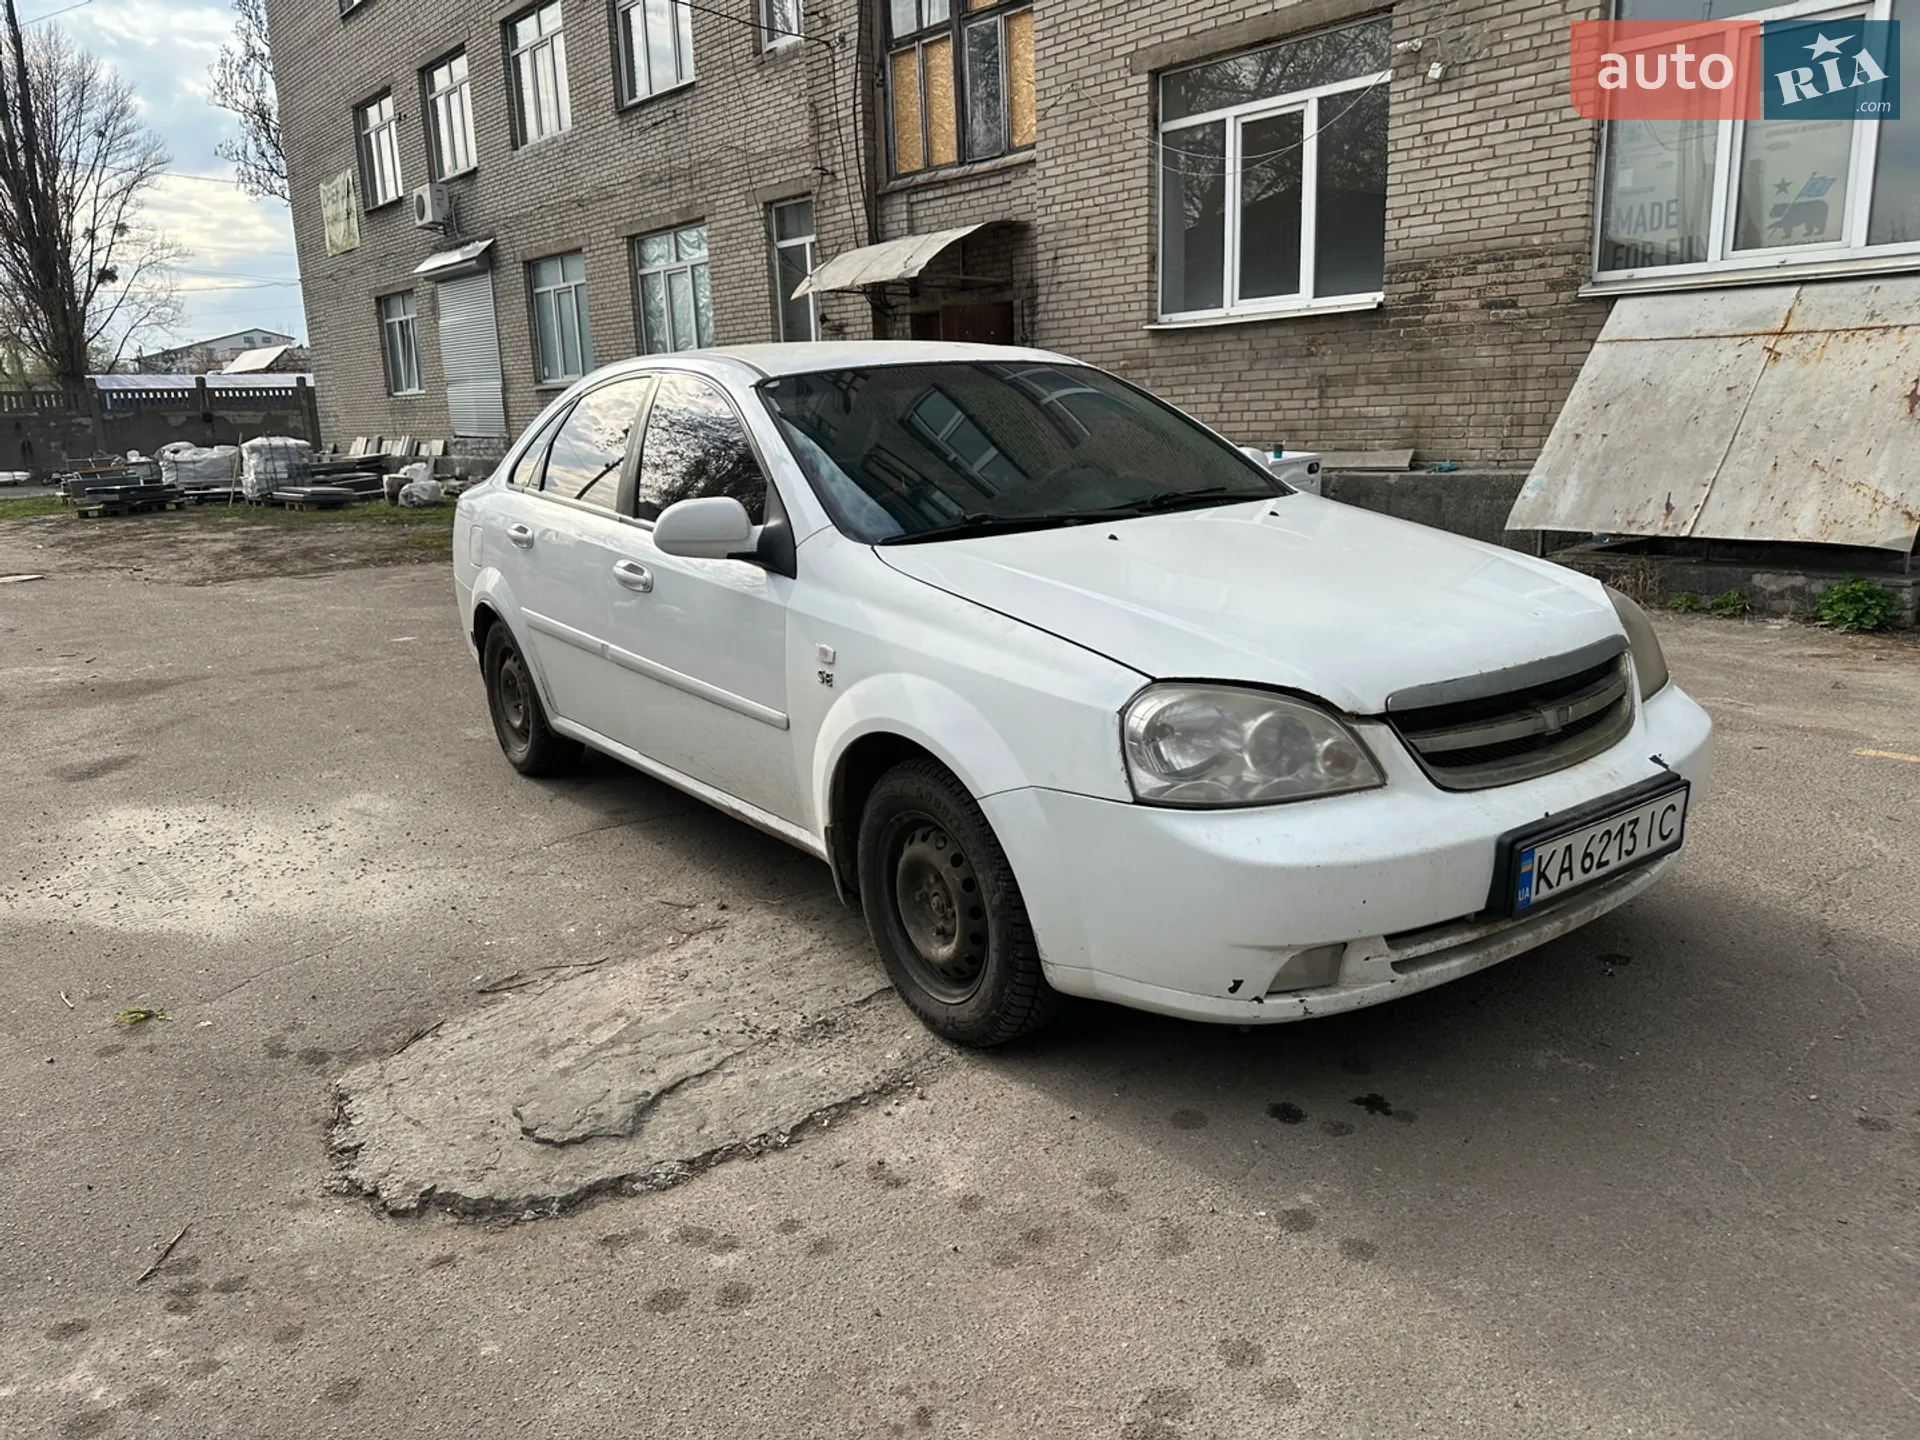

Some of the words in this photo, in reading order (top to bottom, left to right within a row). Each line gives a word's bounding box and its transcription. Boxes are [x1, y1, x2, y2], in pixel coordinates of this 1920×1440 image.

[1614, 198, 1679, 235] MADE
[1535, 843, 1574, 895] KA
[1580, 816, 1640, 875] 6213
[1647, 803, 1676, 849] IC
[1518, 888, 1531, 901] UA
